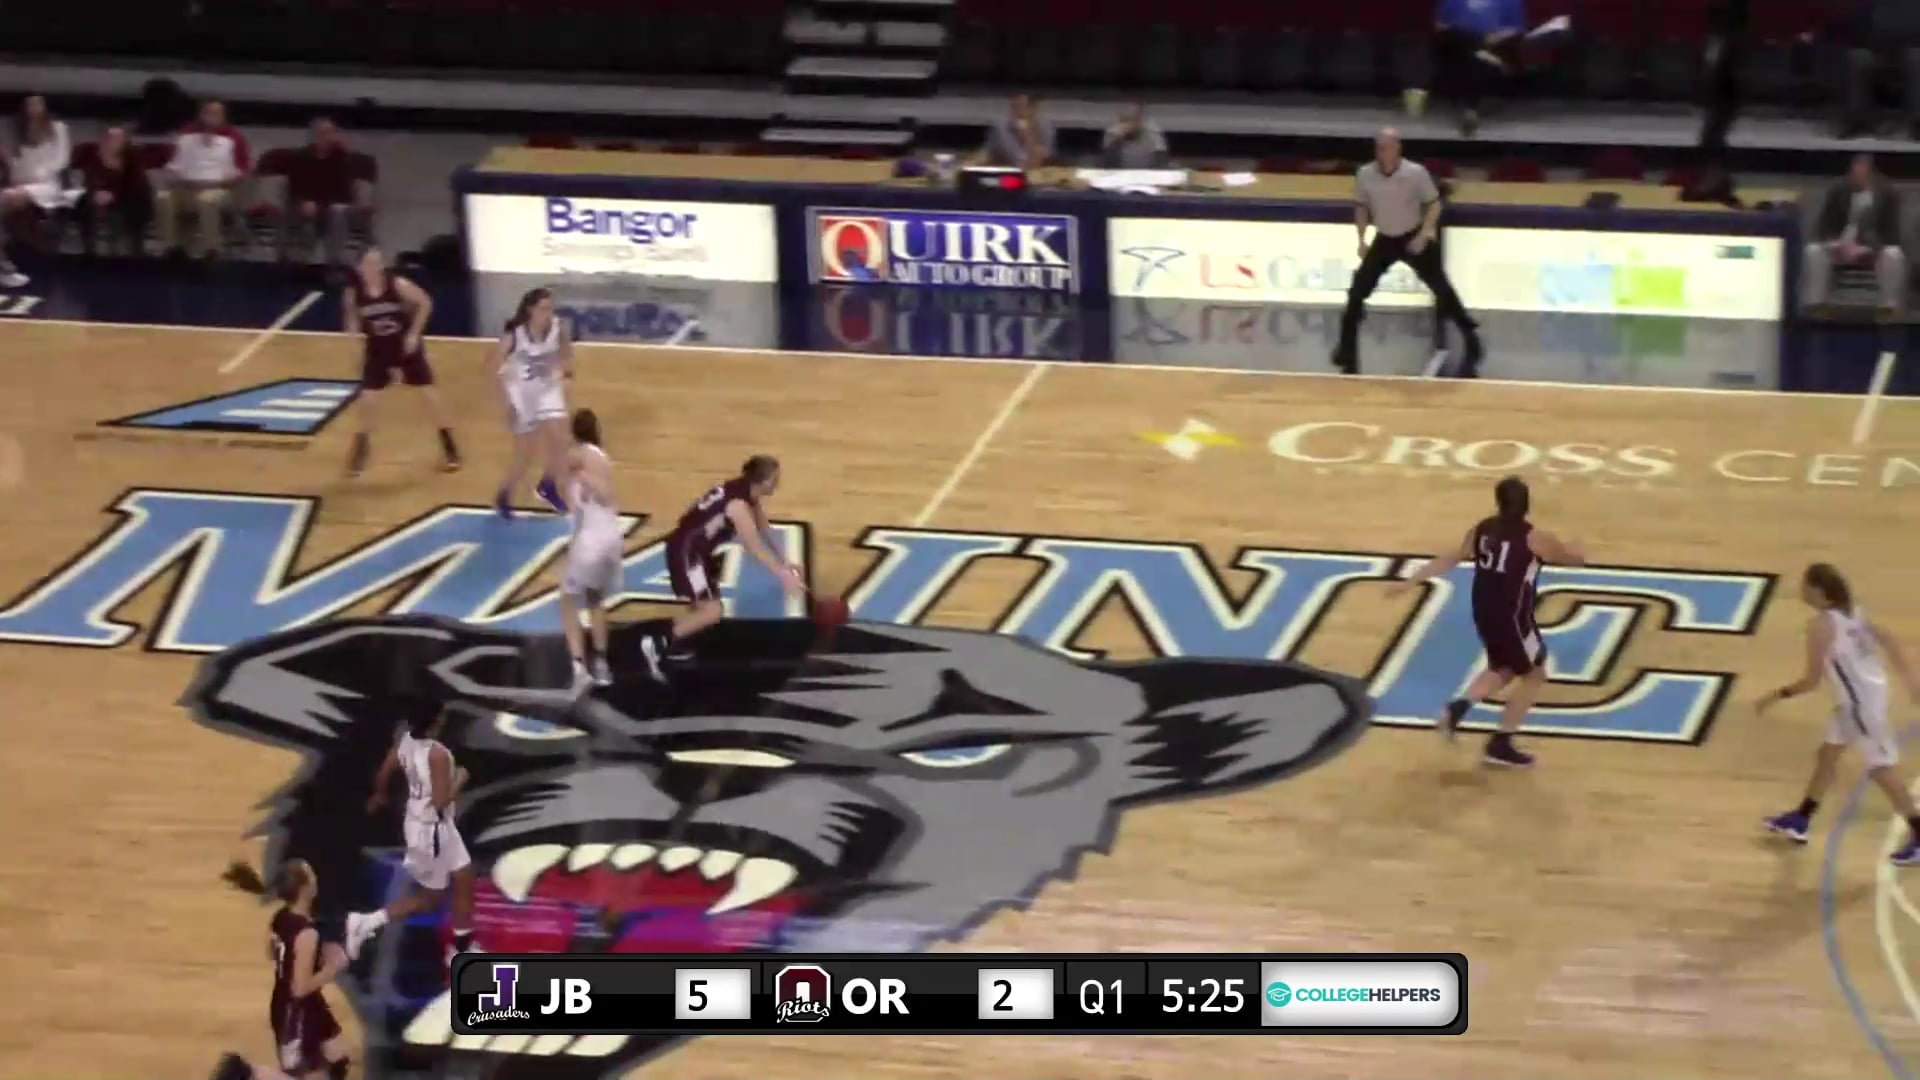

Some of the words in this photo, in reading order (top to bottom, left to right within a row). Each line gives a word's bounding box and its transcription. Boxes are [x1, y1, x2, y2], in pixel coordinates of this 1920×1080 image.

[546, 196, 698, 244] Bangor
[820, 217, 1068, 280] QUIRK
[1267, 420, 1679, 478] CROSS
[1477, 534, 1512, 574] 51
[0, 487, 1777, 744] MAINE
